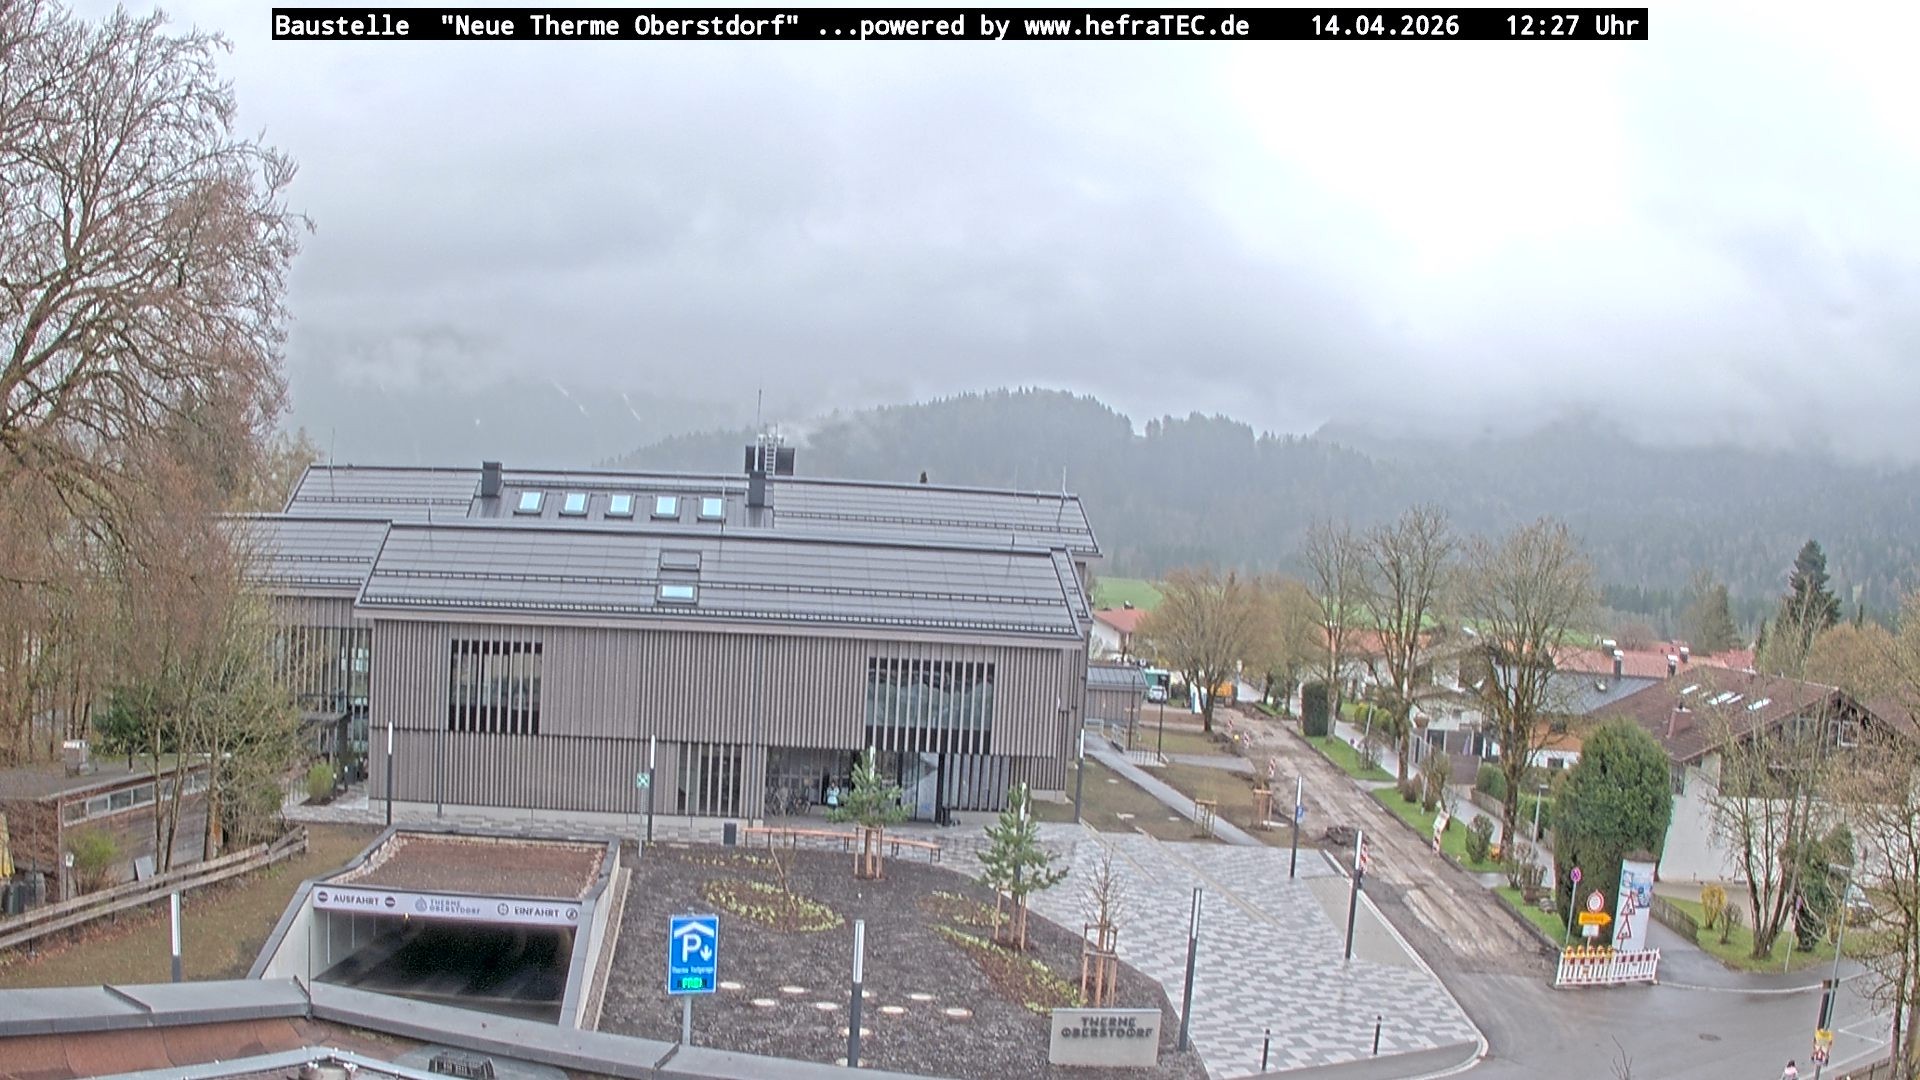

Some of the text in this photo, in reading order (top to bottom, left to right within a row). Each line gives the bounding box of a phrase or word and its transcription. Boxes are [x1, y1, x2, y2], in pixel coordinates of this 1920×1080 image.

[333, 894, 379, 906] AUSFAHRT
[429, 899, 461, 907] THERME
[429, 905, 480, 915] OBERSTDORF
[514, 905, 559, 918] EINFAHRT
[682, 933, 702, 963] P
[1081, 1016, 1136, 1027] THERME
[1061, 1027, 1153, 1038] OBERSTDORF
